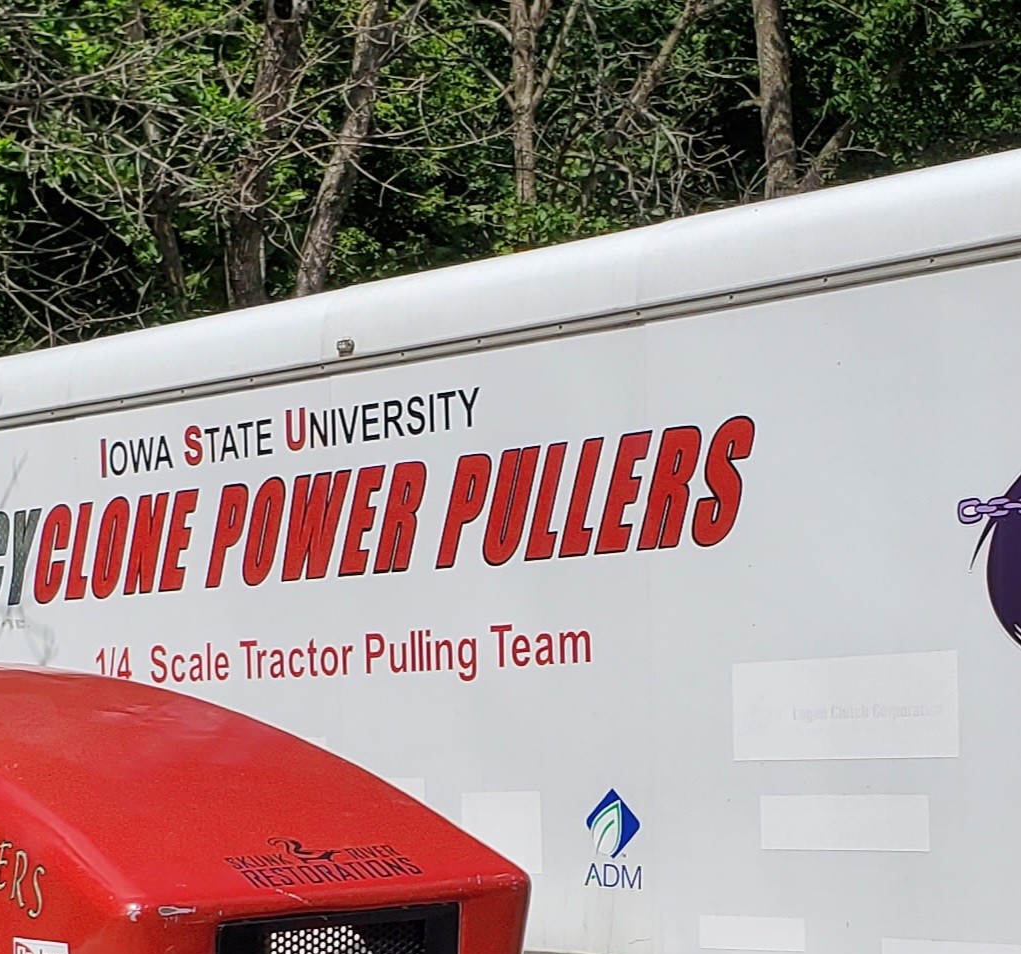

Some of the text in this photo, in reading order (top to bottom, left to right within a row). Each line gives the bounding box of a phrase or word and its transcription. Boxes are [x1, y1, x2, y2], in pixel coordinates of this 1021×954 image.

[99, 386, 481, 479] IOWA STATE UNIVERSITY
[204, 460, 428, 590] POWER
[435, 415, 756, 571] PULLERS
[95, 623, 592, 684] 1/4 Scale Tractor Pulling Team
[224, 844, 403, 870] SKUNK RIVER
[241, 856, 423, 889] RESTORATIONS
[584, 862, 642, 890] ADM
